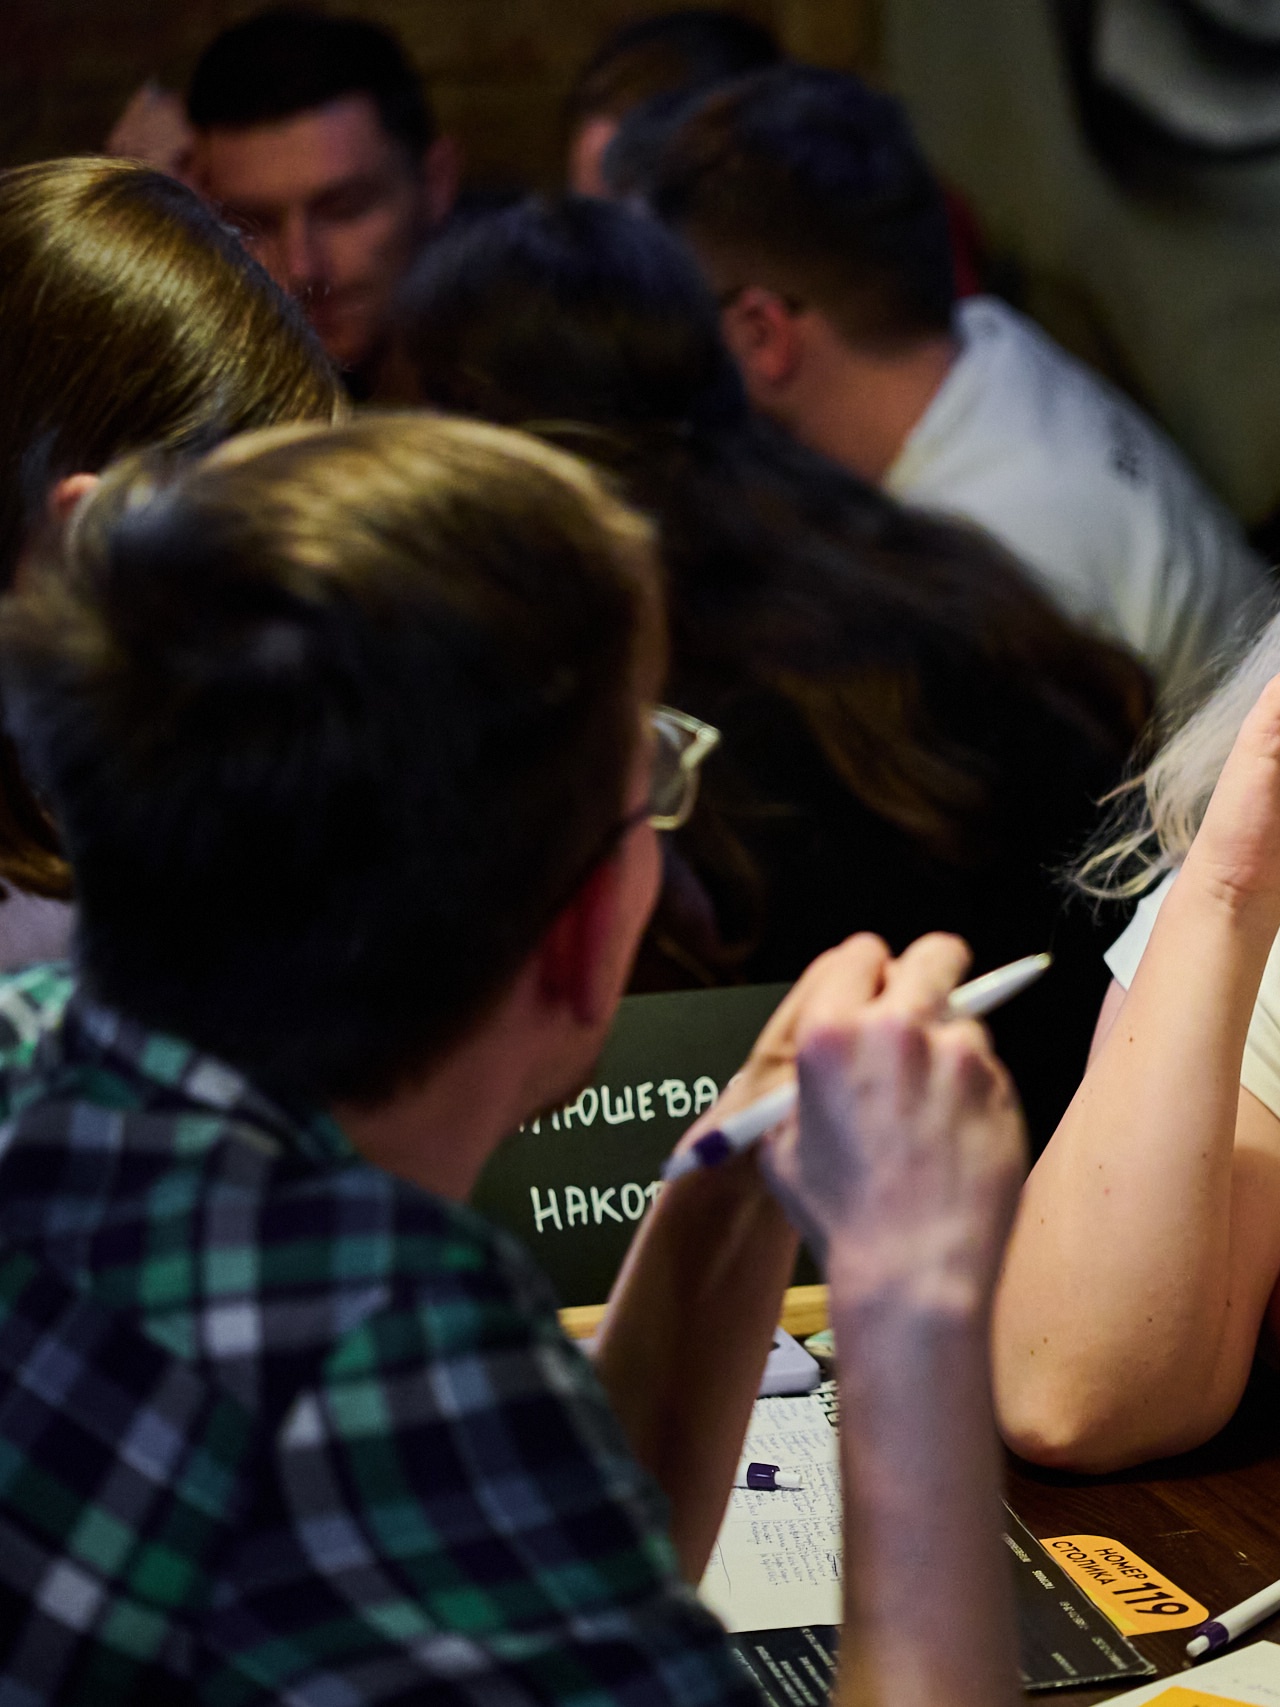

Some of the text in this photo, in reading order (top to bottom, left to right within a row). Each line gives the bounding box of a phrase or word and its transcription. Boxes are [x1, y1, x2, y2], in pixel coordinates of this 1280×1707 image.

[519, 1075, 742, 1134] ЮШЕВА
[1052, 1541, 1119, 1585] СТОЛИКА
[1094, 1547, 1148, 1581] НОМЕР
[1112, 1582, 1190, 1615] 119
